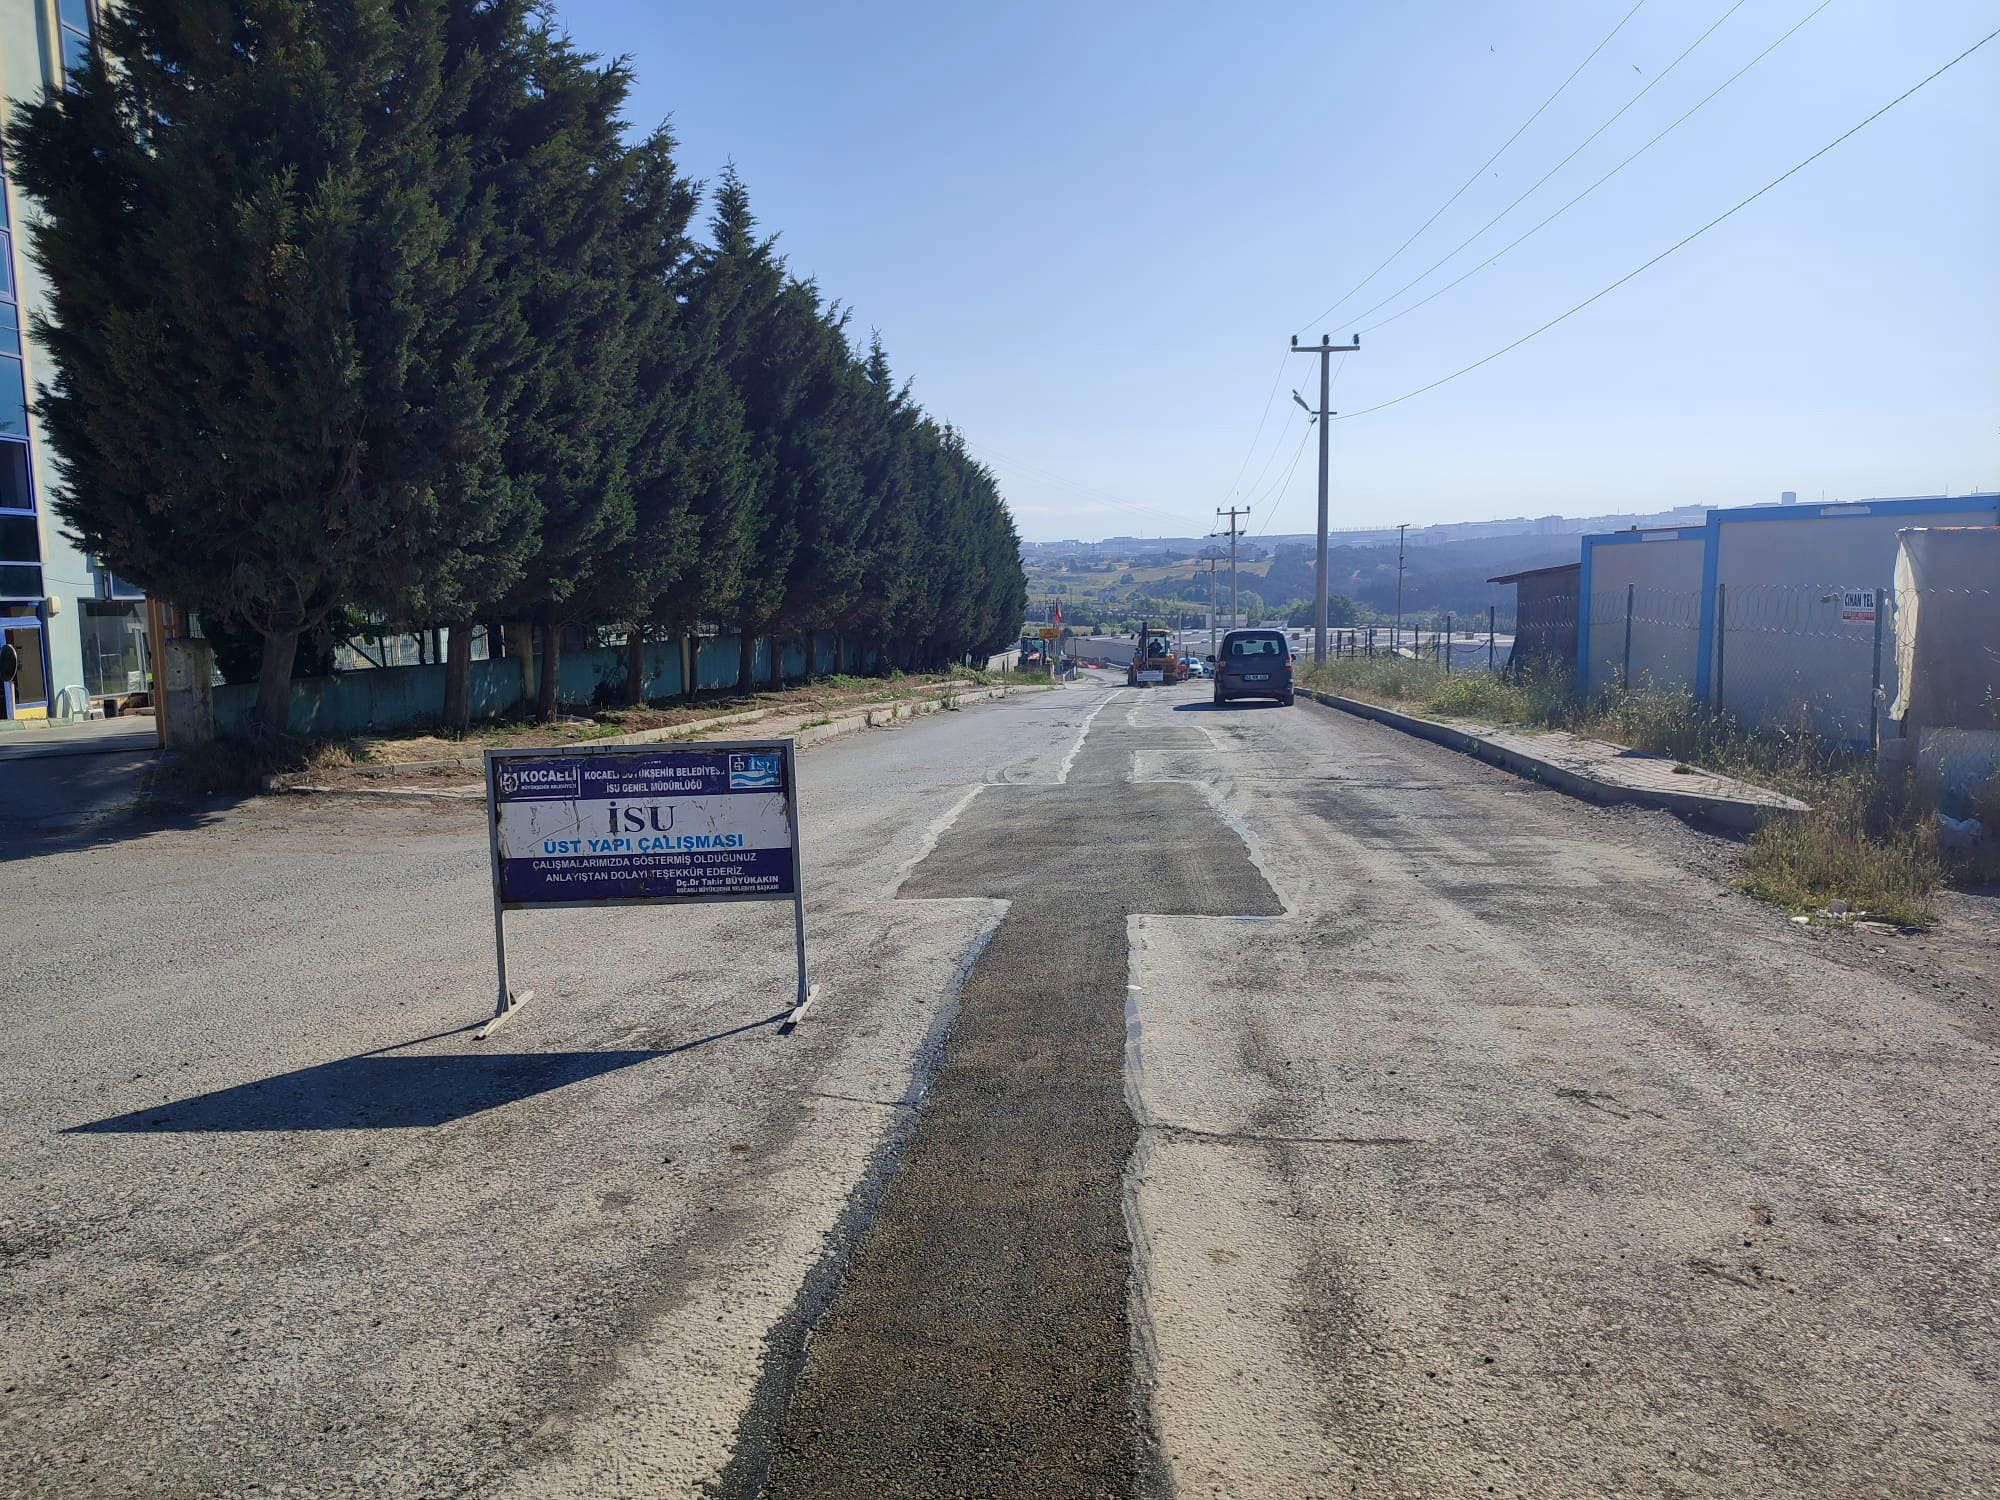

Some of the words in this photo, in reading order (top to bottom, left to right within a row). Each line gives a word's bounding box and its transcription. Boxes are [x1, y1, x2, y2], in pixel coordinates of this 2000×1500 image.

[1863, 592, 1874, 607] TEL
[622, 782, 649, 793] GENEL
[651, 780, 703, 792] MÜDÜRLÜĞÜ
[543, 838, 581, 855] ÜST
[587, 837, 631, 853] YAPI
[637, 833, 744, 854] ÇALIŞMASI
[532, 857, 630, 871] ÇALIŞMALARIMIZDA
[632, 854, 692, 866] GÖSTERMİŞ
[693, 852, 757, 864] OLDUĞUNUZ
[545, 870, 608, 883] ANLAYIŞTAN
[610, 869, 648, 880] DOLAYI
[651, 867, 704, 880] TEŞEKKÜR
[706, 865, 745, 877] EDERİZ.
[701, 877, 724, 886] Tahir
[725, 875, 779, 885] BÜYÜKAKIN
